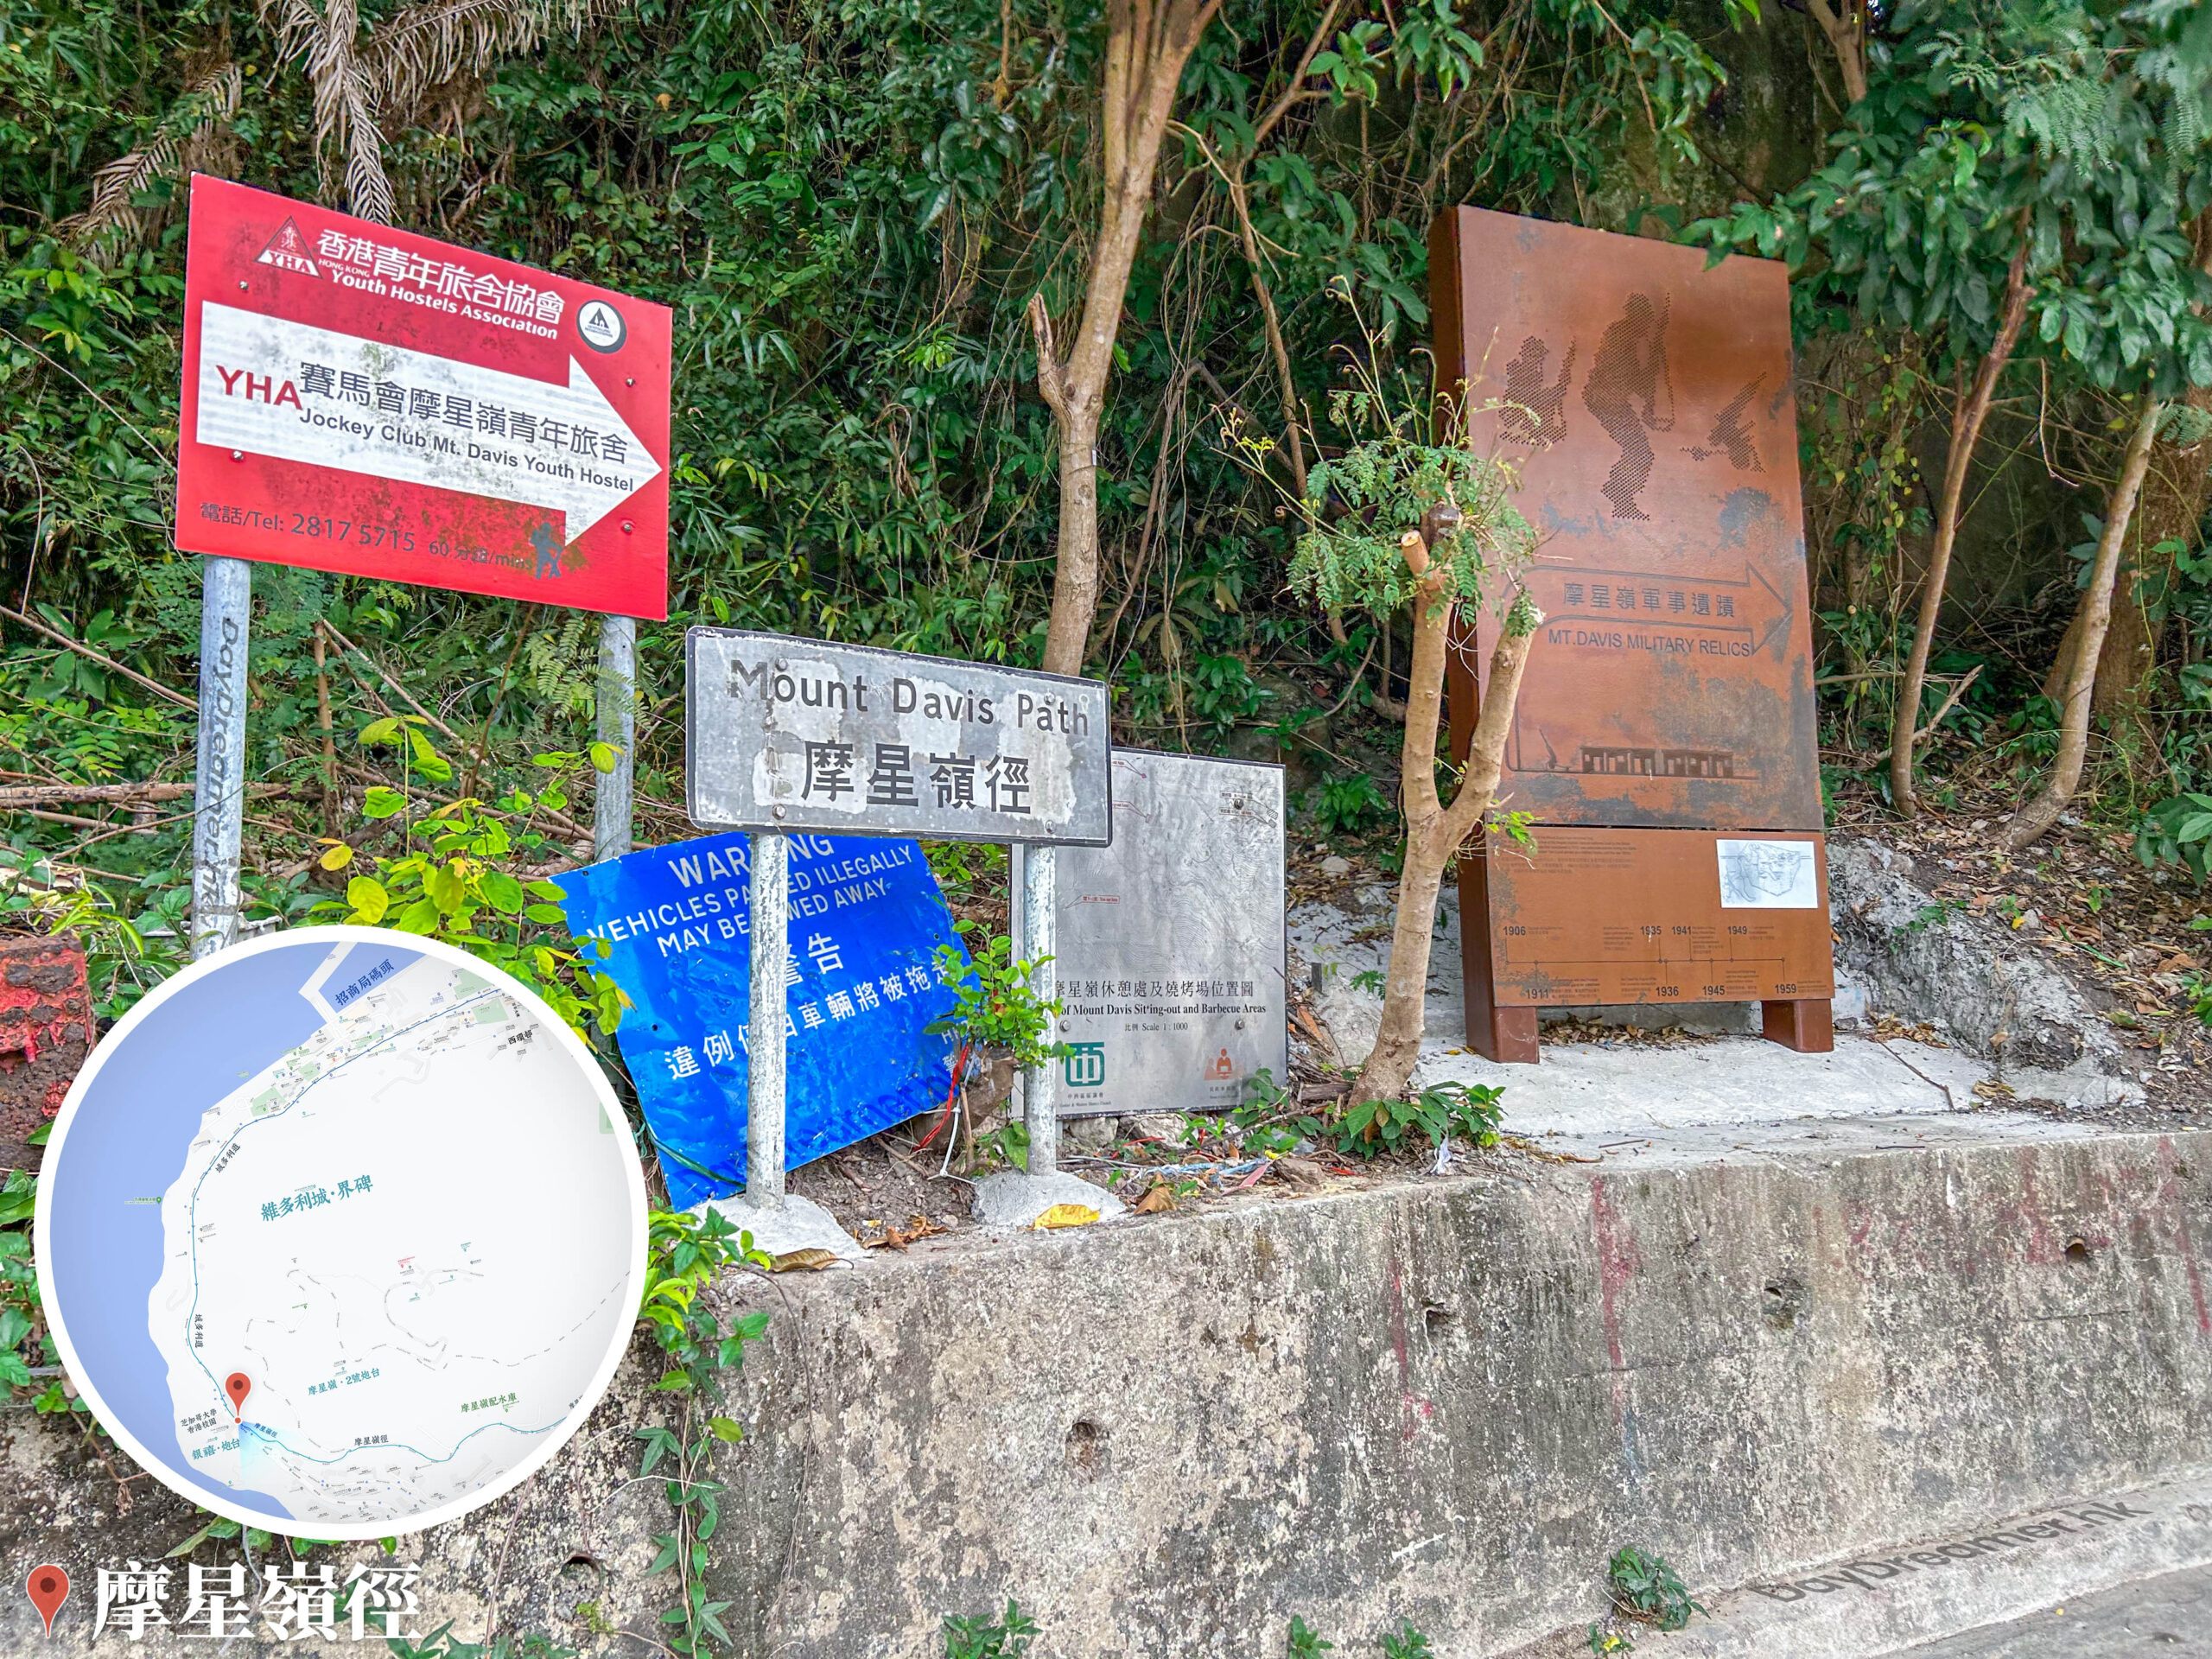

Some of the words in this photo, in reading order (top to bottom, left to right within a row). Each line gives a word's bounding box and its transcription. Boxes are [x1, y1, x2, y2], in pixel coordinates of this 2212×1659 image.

[316, 228, 567, 326] 香港青年旅舍協會
[318, 257, 345, 272] HONG
[345, 265, 371, 279] KONG
[331, 269, 386, 296] Youth
[391, 284, 458, 315] Hostels
[460, 303, 558, 340] Association
[216, 365, 302, 411] YHA
[300, 361, 629, 465] 賽馬會摩星嶺青年旅舍
[300, 408, 374, 441] Jockey
[381, 424, 427, 448] Club
[433, 435, 461, 456] Mt.
[467, 442, 518, 467] Davis
[524, 454, 575, 480] Youth
[580, 467, 634, 493] Hostel
[290, 512, 352, 542] 2817
[359, 524, 416, 552] 5715
[429, 539, 450, 559] 60
[1626, 632, 1696, 654] MILITARY
[1699, 639, 1751, 658] RELICS
[728, 659, 868, 714] Mount
[893, 677, 995, 726] Davis
[1017, 692, 1090, 737] Path
[800, 739, 1033, 815] 摩星嶺徑
[587, 893, 721, 942] VEHICLES
[814, 845, 913, 886] ILLEGALLY
[657, 922, 711, 958] MAY
[717, 913, 750, 939] BE
[834, 877, 887, 908] AWAY
[1503, 925, 1526, 936] 1906
[1640, 925, 1662, 936] 1935
[1671, 925, 1692, 936] 1941
[1727, 925, 1748, 936] 1949
[1525, 988, 1549, 1000] 1911
[1656, 986, 1680, 997] 1936
[1702, 985, 1726, 996] 1945
[1774, 983, 1797, 994] 1959
[1072, 1003, 1104, 1015] Mount
[1106, 1003, 1132, 1015] Davis
[1183, 1003, 1199, 1014] and
[1202, 1002, 1241, 1014] Barbecue
[1243, 1003, 1267, 1014] Areas
[1141, 1022, 1160, 1032] Scale
